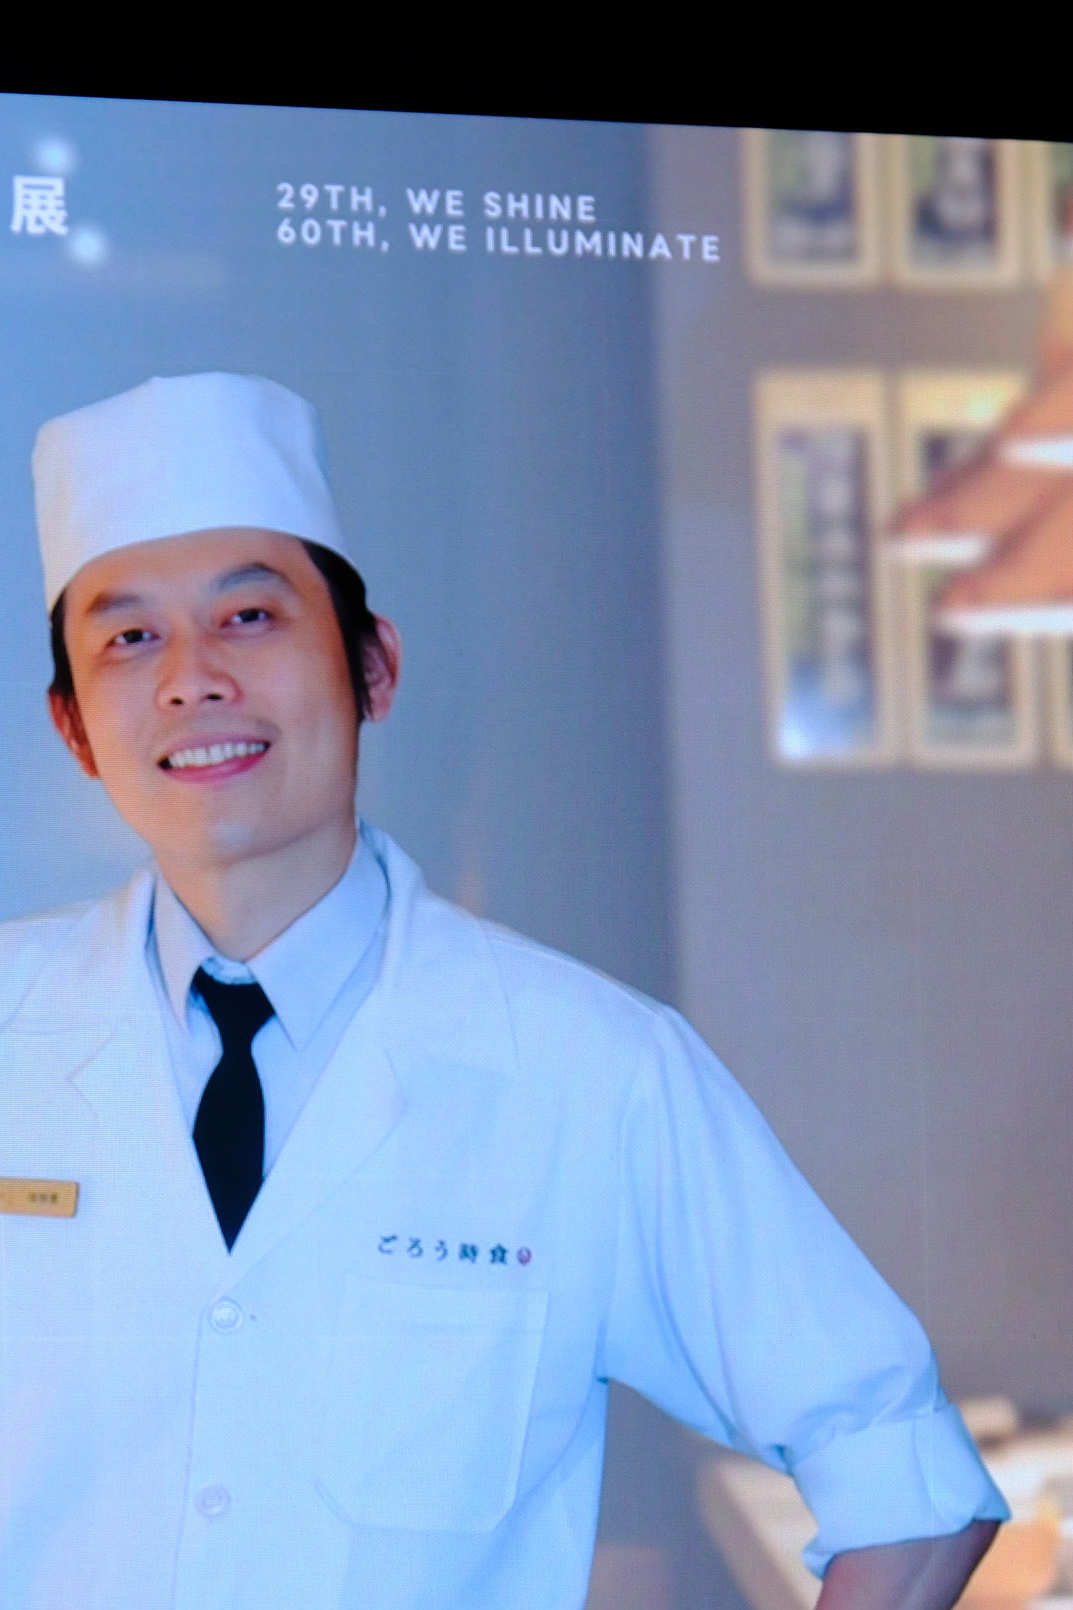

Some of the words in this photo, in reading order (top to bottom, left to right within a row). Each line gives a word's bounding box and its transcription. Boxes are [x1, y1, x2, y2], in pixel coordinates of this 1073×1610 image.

[276, 182, 387, 217] 29TH,
[406, 188, 464, 217] WE
[483, 191, 596, 223] SHINE
[277, 217, 389, 252] 60TH,
[408, 223, 467, 251] WE
[485, 226, 721, 261] ILLUMINATE
